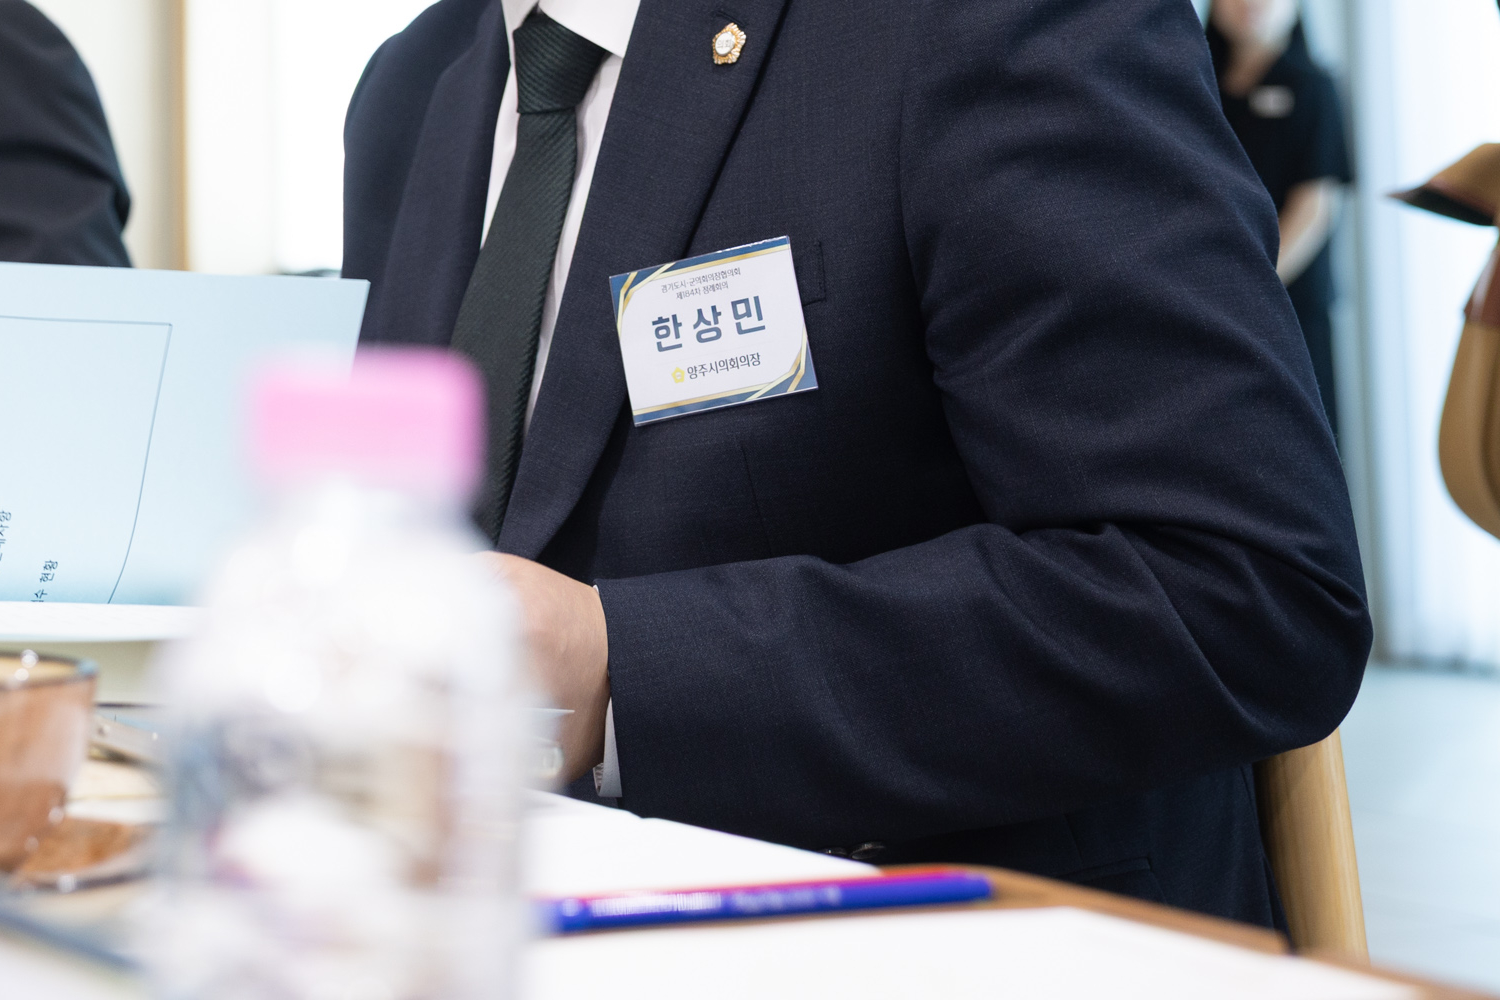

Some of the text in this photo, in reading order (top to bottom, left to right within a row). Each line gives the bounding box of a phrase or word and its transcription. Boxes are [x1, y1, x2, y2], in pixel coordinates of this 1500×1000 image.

[676, 281, 729, 300] 제184차 정례회의
[687, 352, 761, 380] 양주시의회의장
[39, 560, 59, 583] 현황
